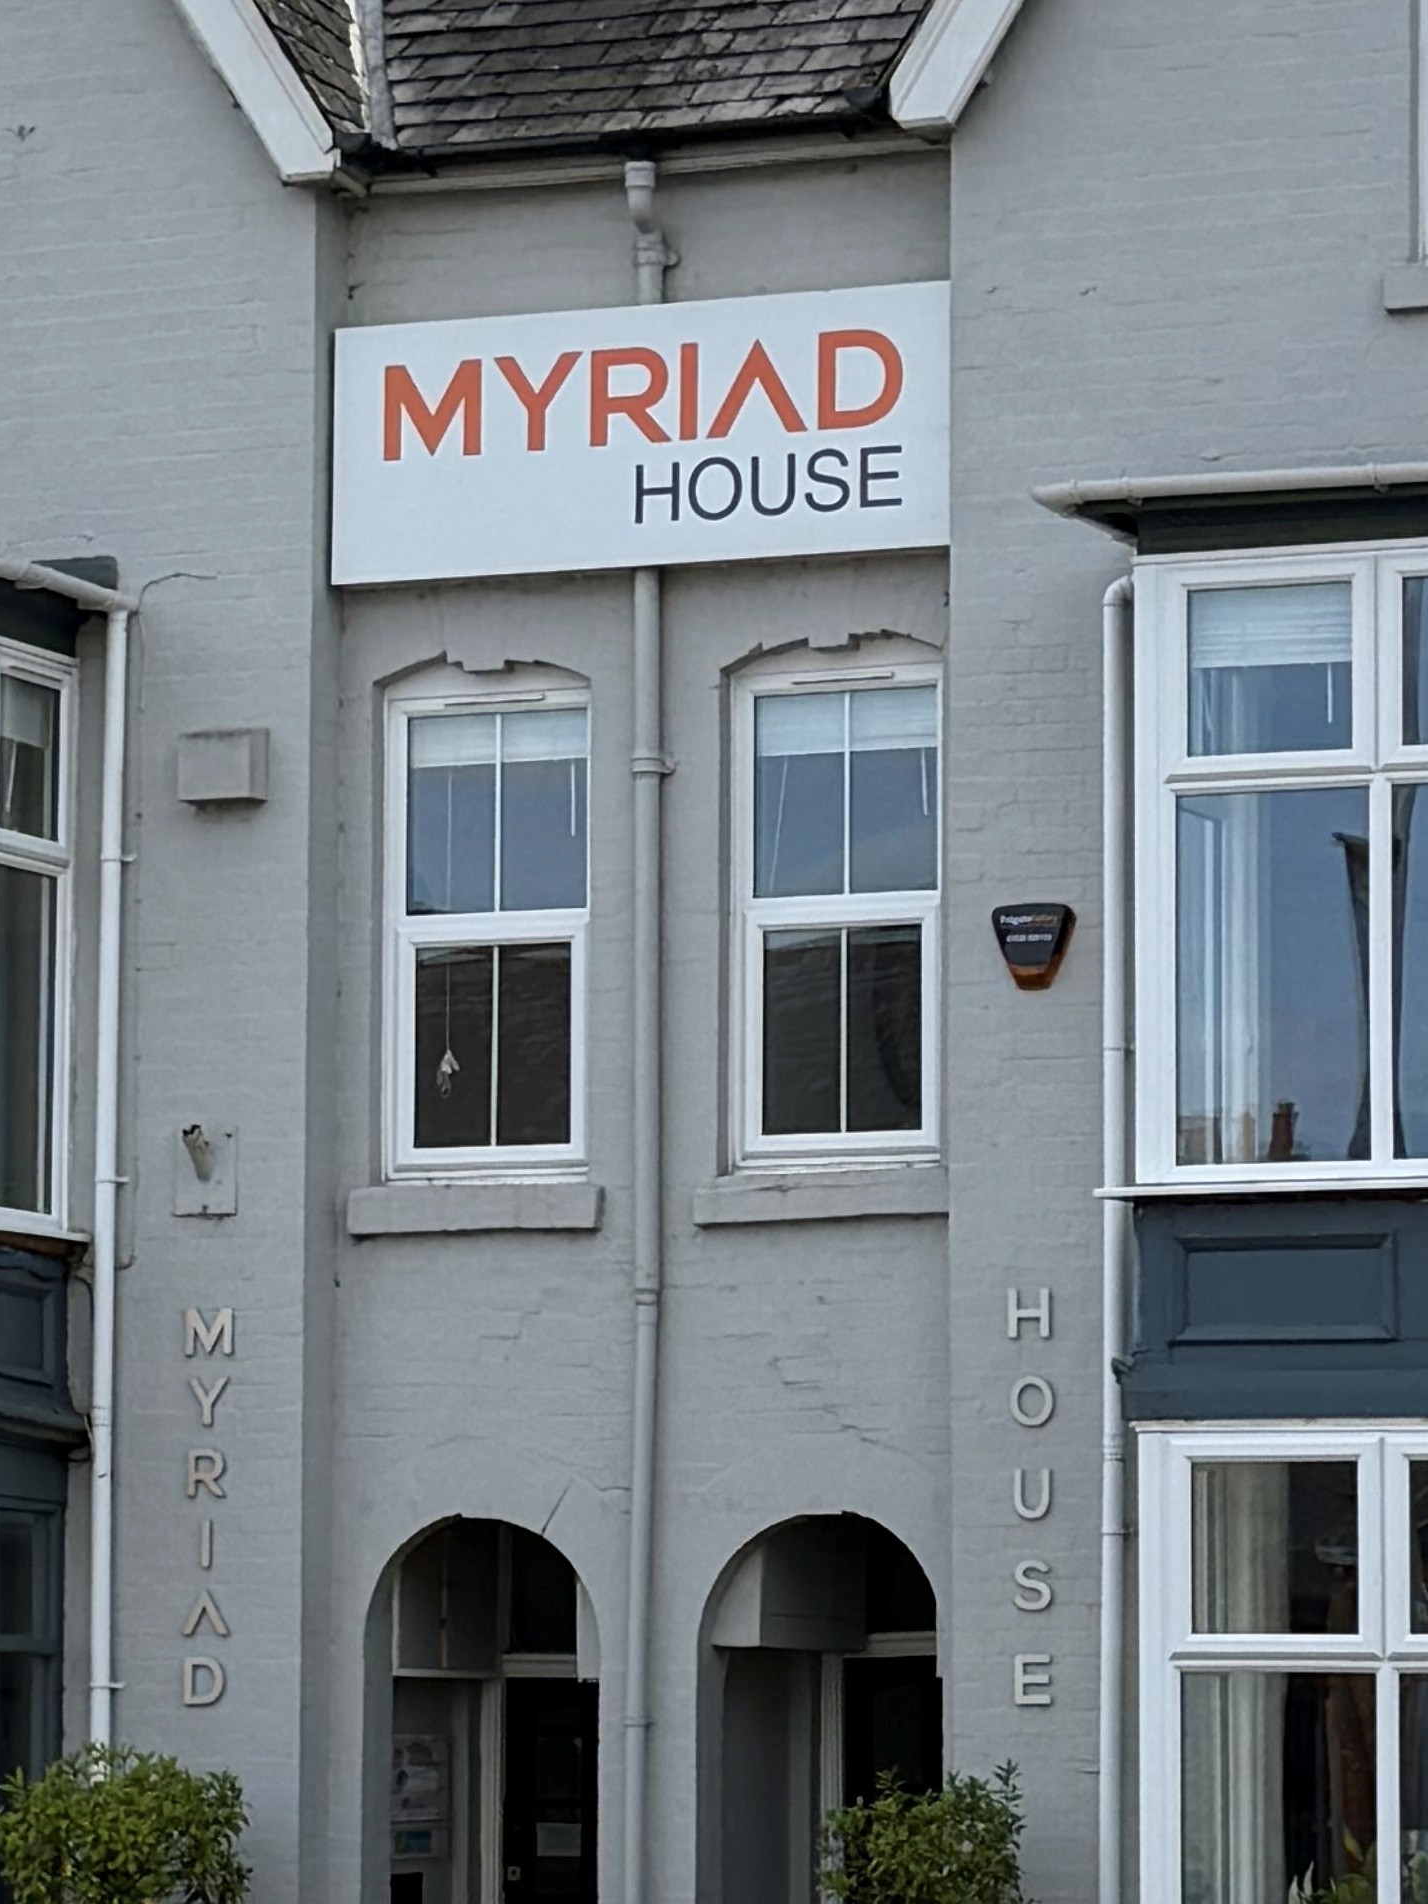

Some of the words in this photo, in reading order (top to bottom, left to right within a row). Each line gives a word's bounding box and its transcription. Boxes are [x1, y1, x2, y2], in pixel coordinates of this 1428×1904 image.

[382, 329, 904, 461] MYRIAD
[634, 445, 903, 524] HOUSE
[182, 1307, 235, 1707] MYRIAD
[1006, 1288, 1055, 1707] HOUSE
